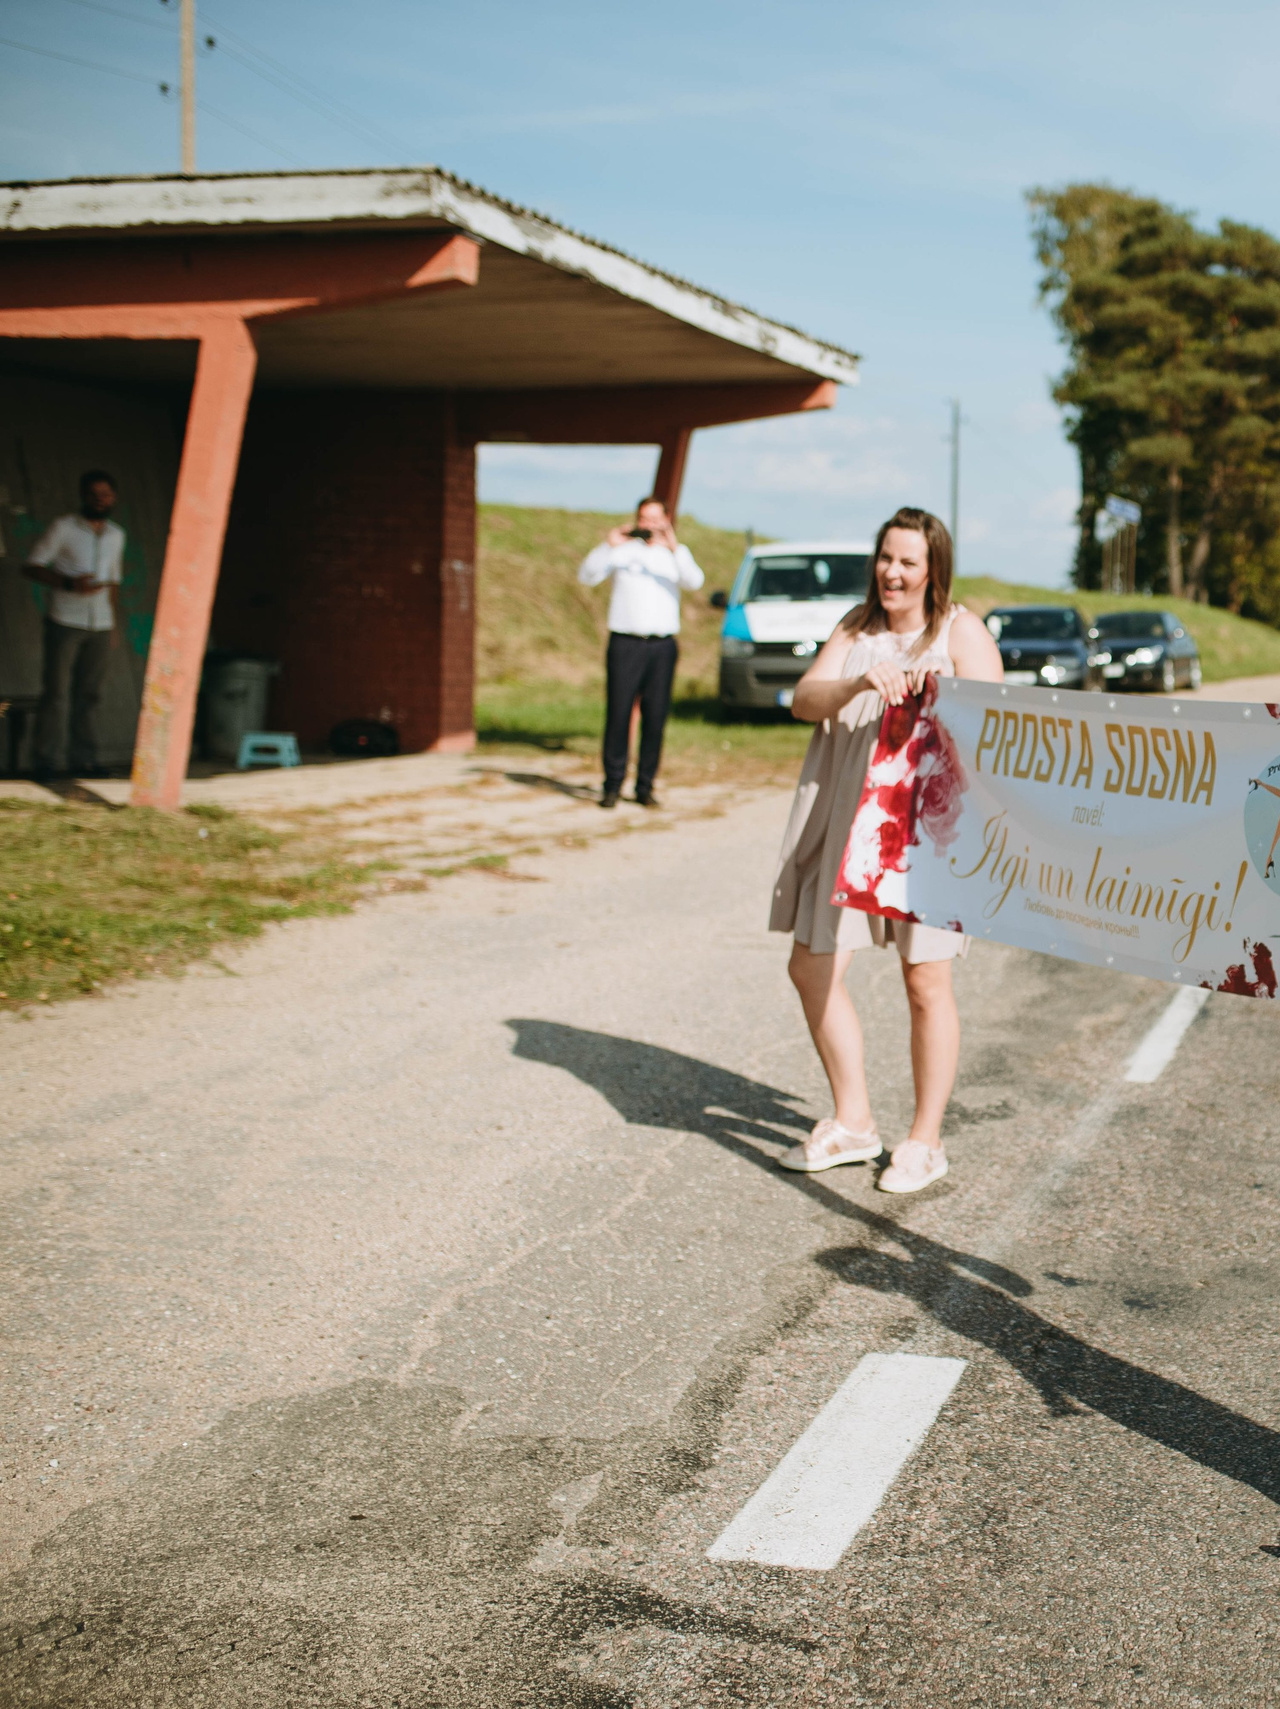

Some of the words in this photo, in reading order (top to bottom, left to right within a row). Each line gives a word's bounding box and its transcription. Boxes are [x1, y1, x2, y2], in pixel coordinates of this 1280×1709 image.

[976, 708, 1094, 789] PROSTA
[1103, 723, 1217, 806] SOSNA
[949, 809, 1032, 919] Ilgi
[1038, 862, 1077, 902] un
[1084, 846, 1248, 963] laimīgi!
